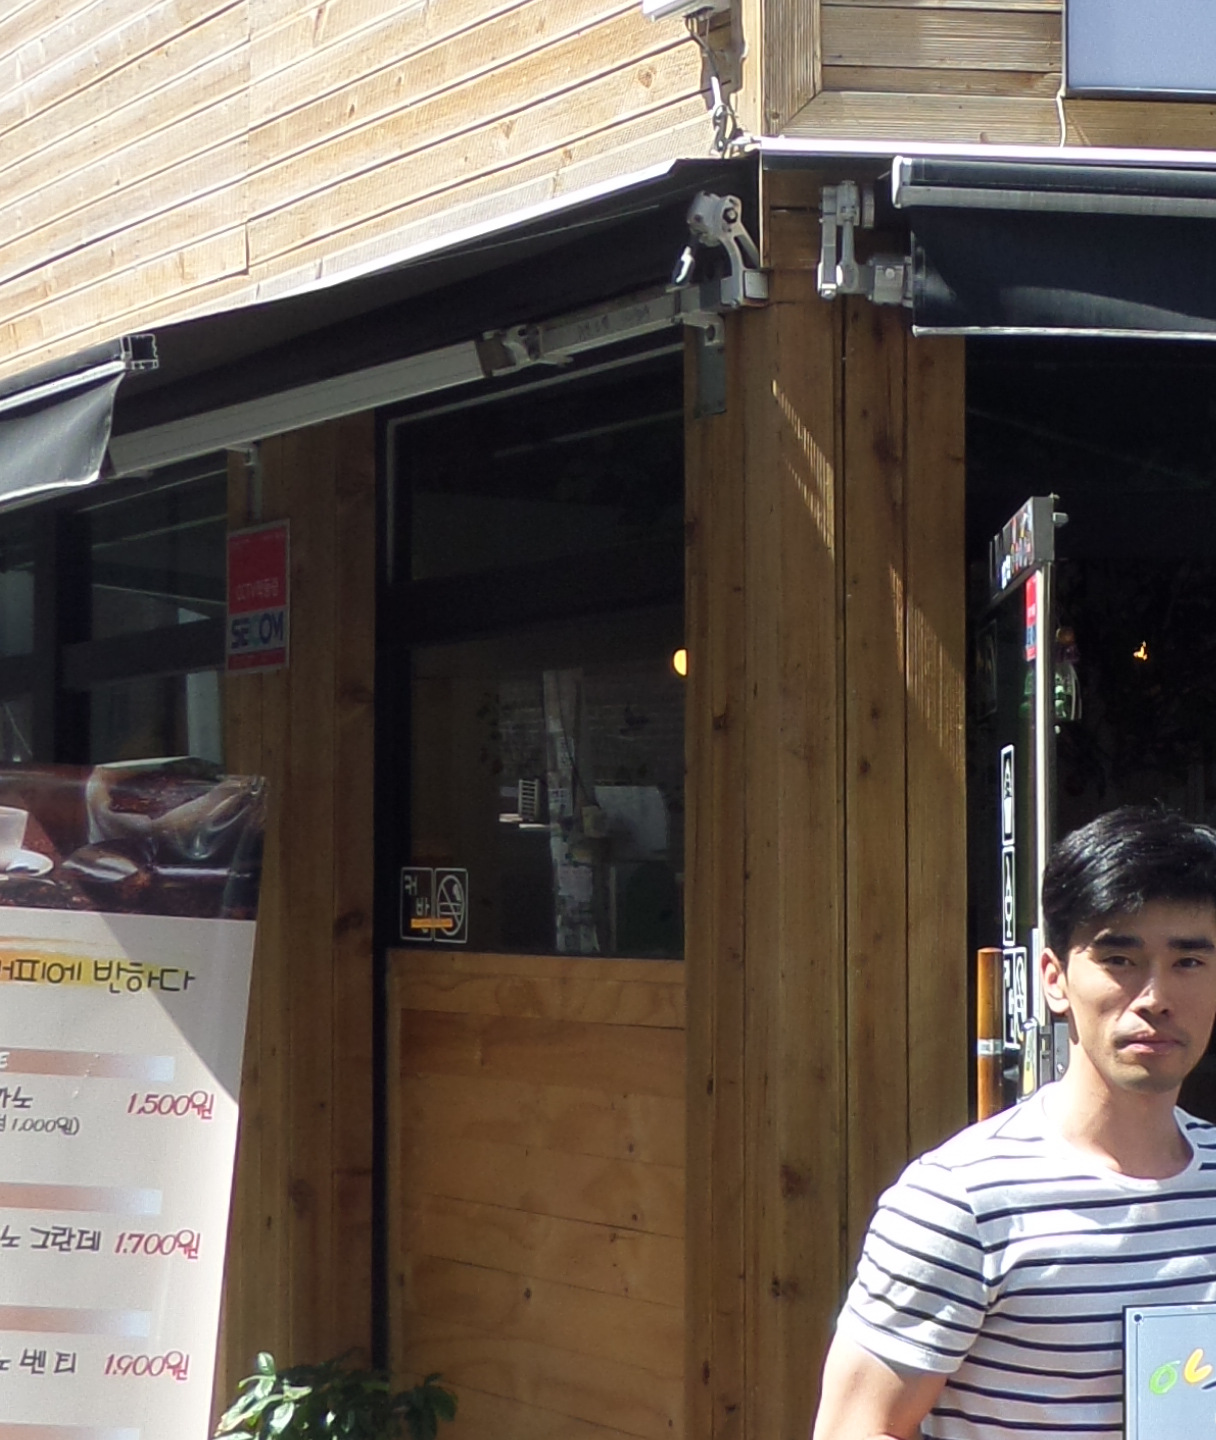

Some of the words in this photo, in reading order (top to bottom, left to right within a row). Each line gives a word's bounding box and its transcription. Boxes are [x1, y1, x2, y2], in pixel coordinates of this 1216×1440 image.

[93, 960, 196, 994] 반하다
[127, 1090, 214, 1121] 1.500원
[30, 1225, 101, 1252] 그란데
[114, 1229, 201, 1260] 1.700원
[104, 1350, 190, 1381] 1.900원
